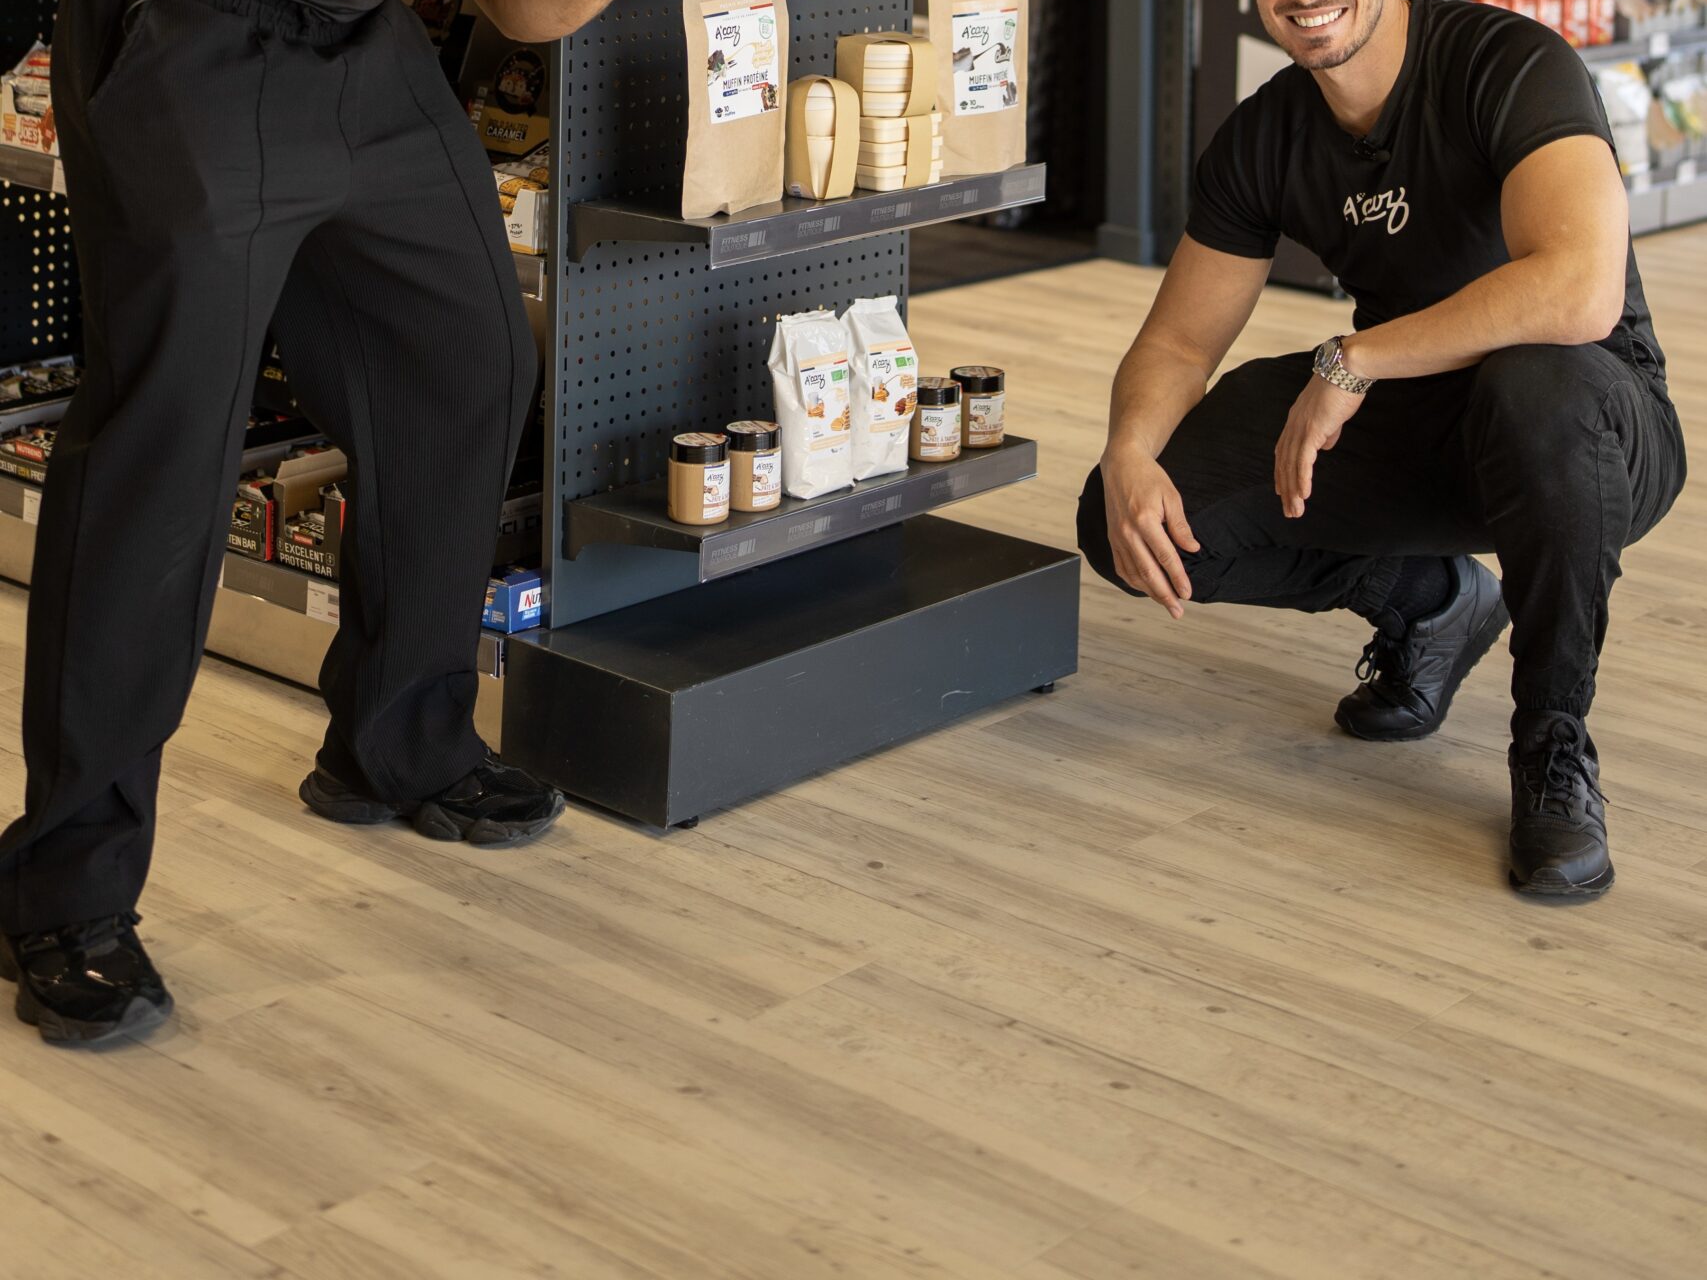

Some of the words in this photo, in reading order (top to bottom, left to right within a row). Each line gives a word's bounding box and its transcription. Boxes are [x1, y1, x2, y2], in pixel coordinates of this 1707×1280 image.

[723, 77, 743, 90] MUFFIN
[968, 74, 992, 85] MUFFIN
[486, 125, 526, 142] CARAMEL
[871, 205, 896, 217] FITNESS
[798, 218, 824, 230] FITNESS
[721, 233, 748, 246] FITNESS
[861, 498, 886, 513] FITNESS
[788, 520, 814, 535] FITNESS
[242, 537, 257, 551] BAR
[711, 543, 738, 558] FITNESS
[284, 542, 325, 563] EXCELENT
[279, 551, 313, 571] PROTEIN
[314, 561, 333, 578] BAR
